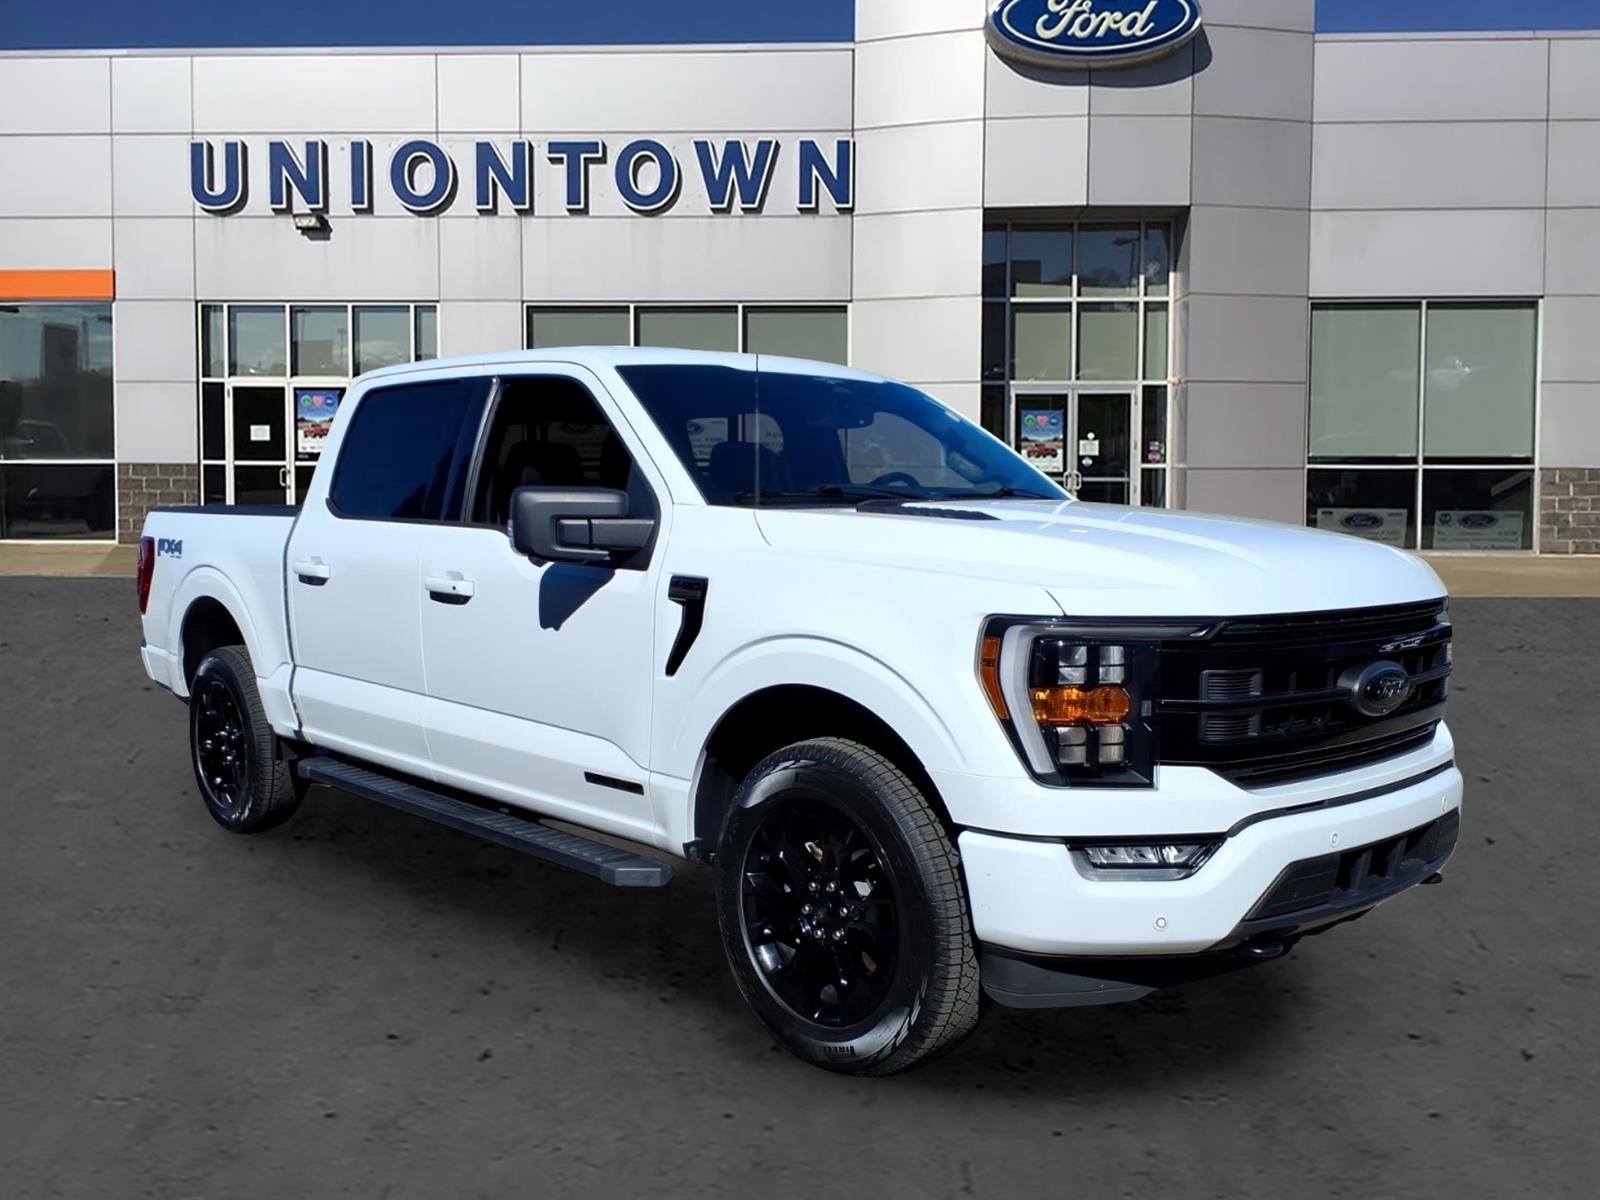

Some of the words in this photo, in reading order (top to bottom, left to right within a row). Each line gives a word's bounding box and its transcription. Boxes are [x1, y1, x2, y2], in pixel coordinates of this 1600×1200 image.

[1035, 0, 1155, 39] Ford
[190, 139, 855, 214] UNIONTOWN
[157, 538, 183, 557] FX4
